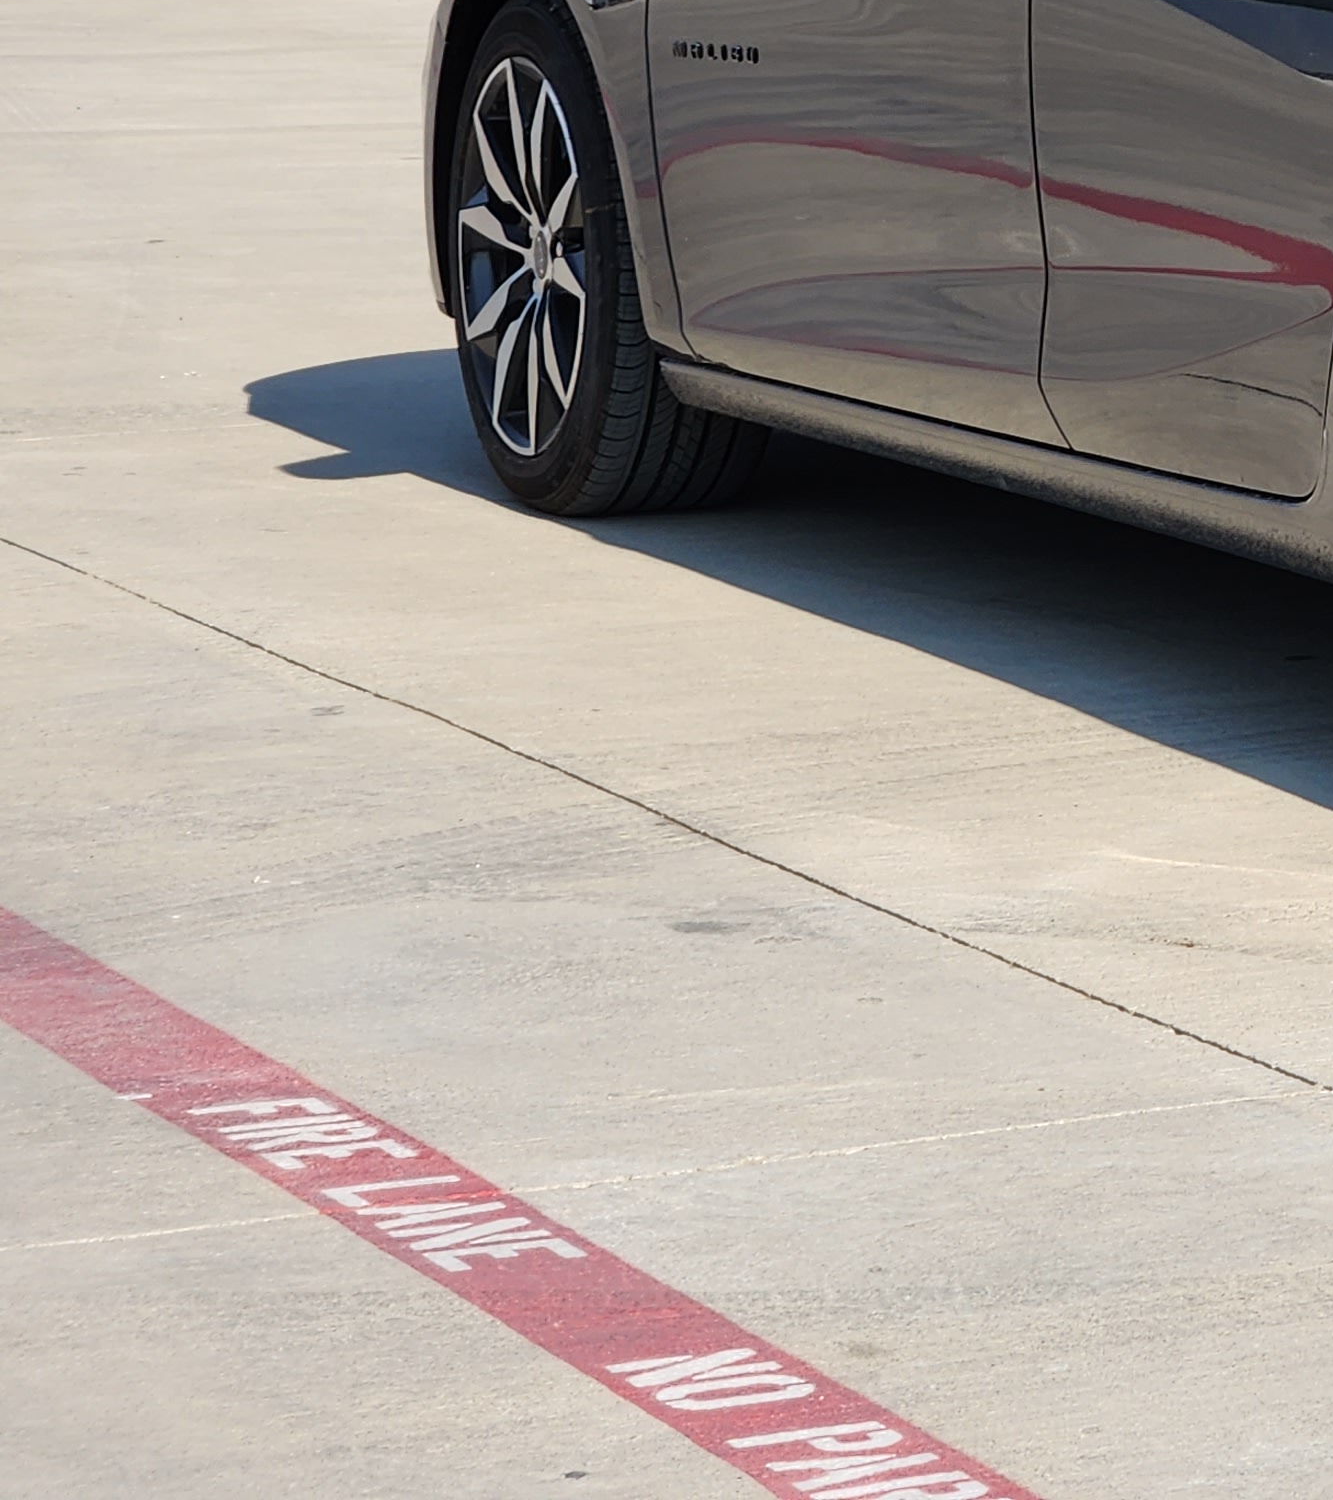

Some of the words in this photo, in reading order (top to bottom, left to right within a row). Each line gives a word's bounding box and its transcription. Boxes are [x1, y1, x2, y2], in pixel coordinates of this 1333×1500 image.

[186, 1097, 419, 1171] FIRE
[321, 1174, 588, 1273] LANE
[605, 1347, 816, 1411] NO
[724, 1420, 1013, 1500] PAR
